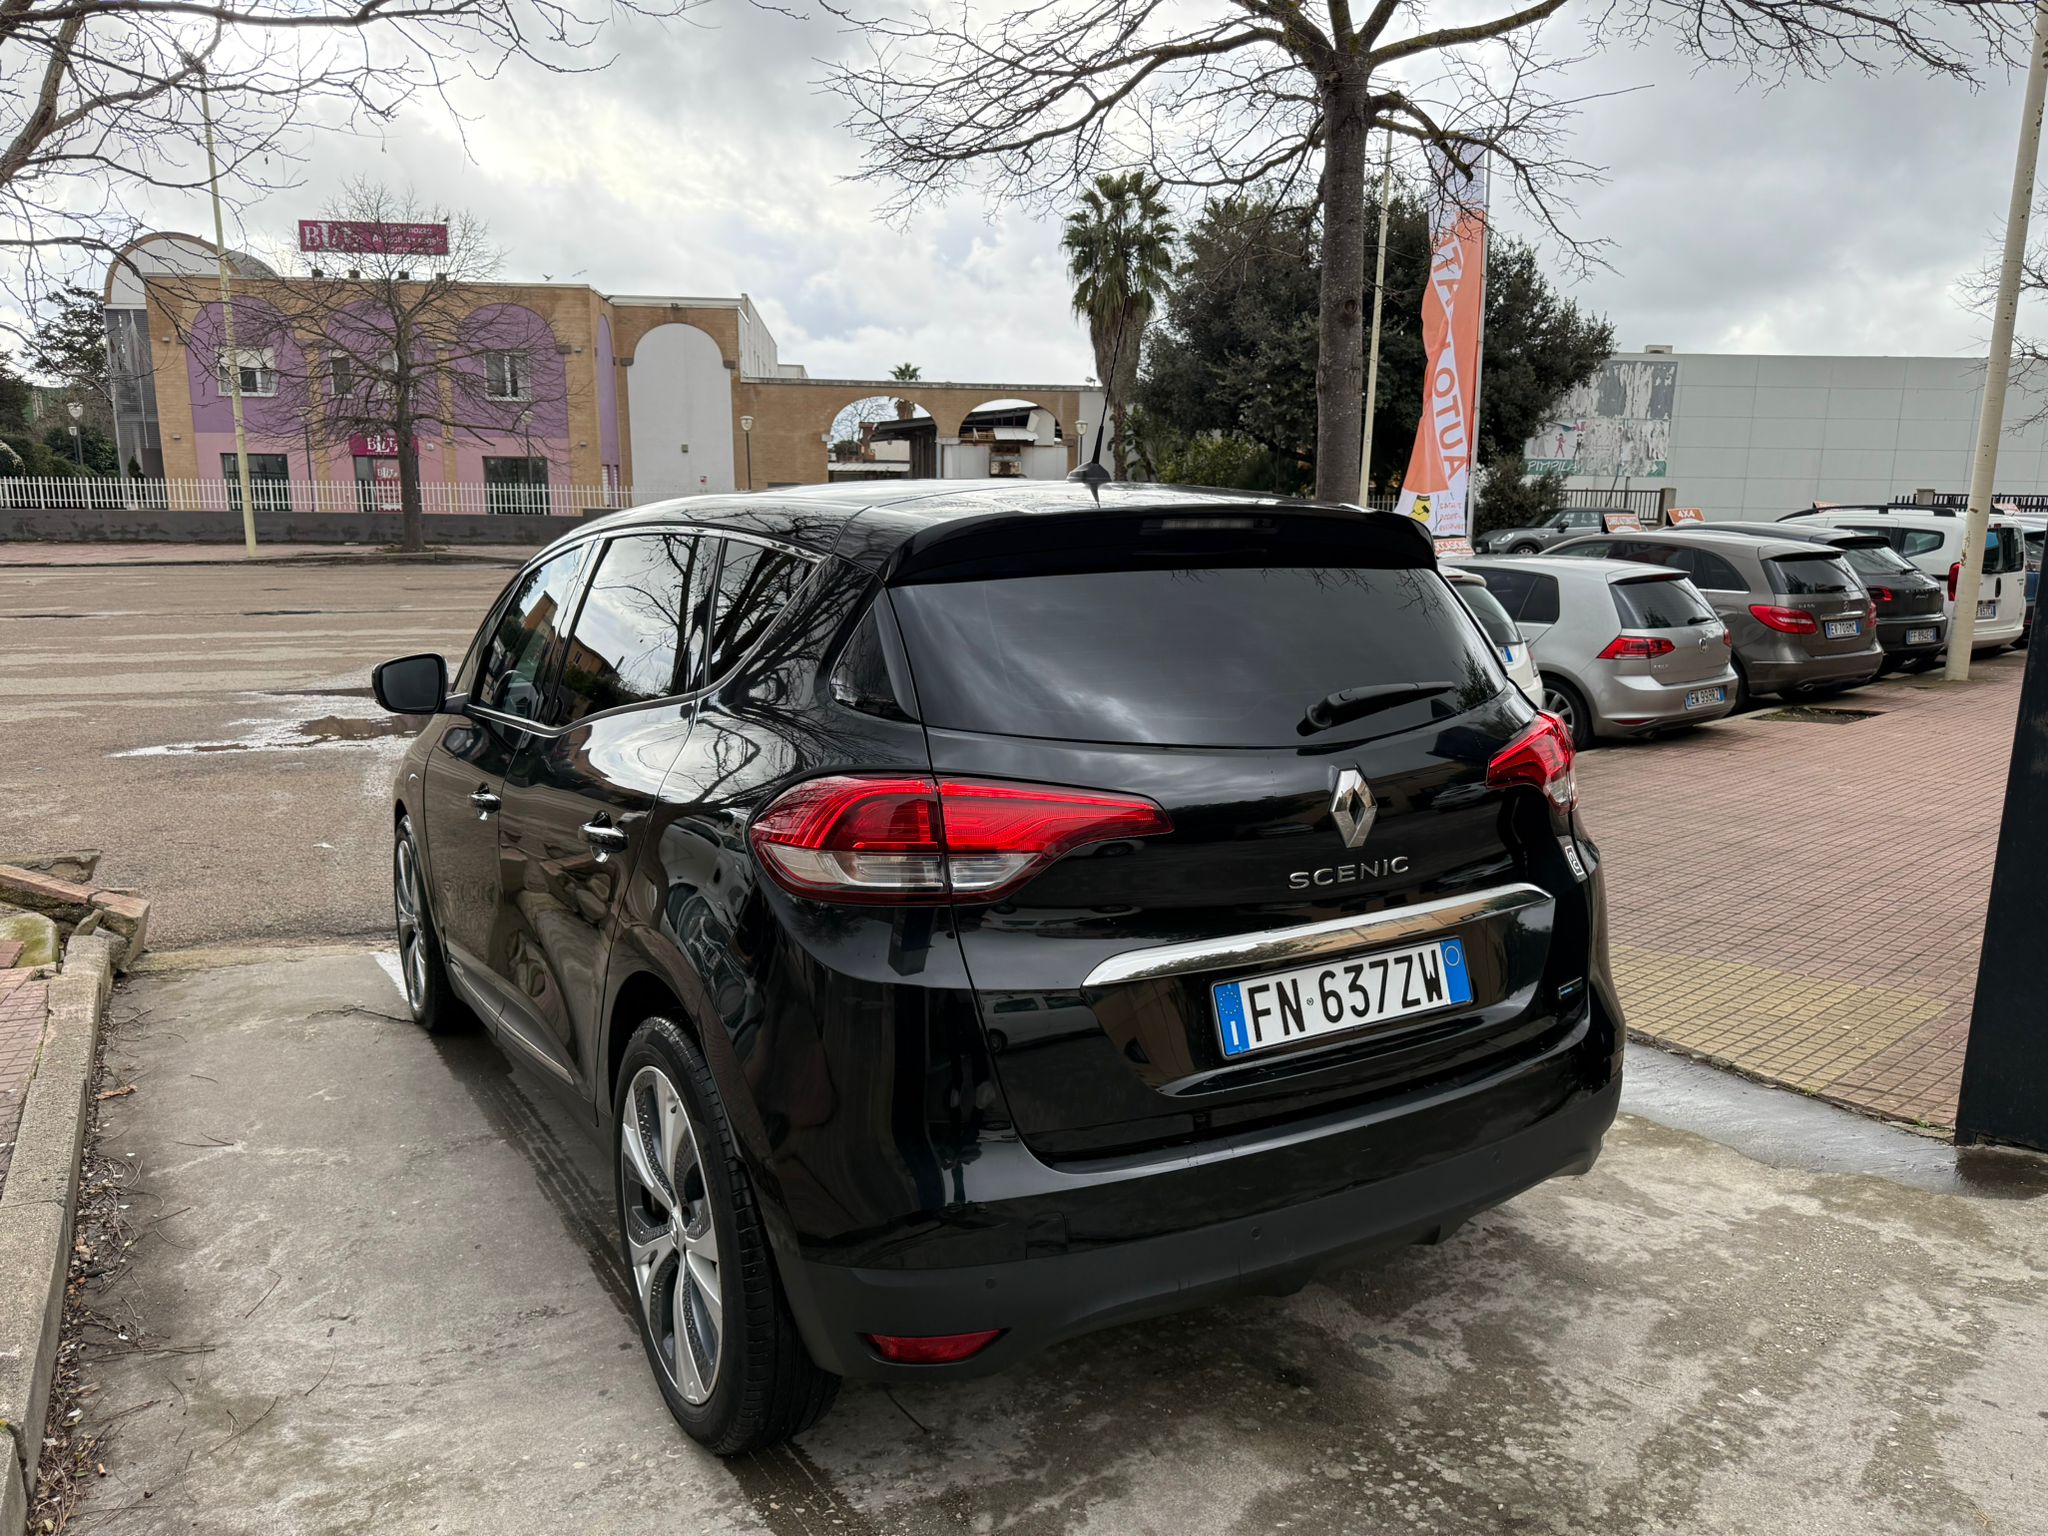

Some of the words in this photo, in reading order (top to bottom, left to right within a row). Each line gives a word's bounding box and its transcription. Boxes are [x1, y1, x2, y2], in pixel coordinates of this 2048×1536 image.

[1678, 510, 1696, 518] 4X4
[1288, 855, 1409, 889] SCENIC
[1247, 978, 1306, 1042] FN
[1318, 949, 1444, 1024] 637ZW
